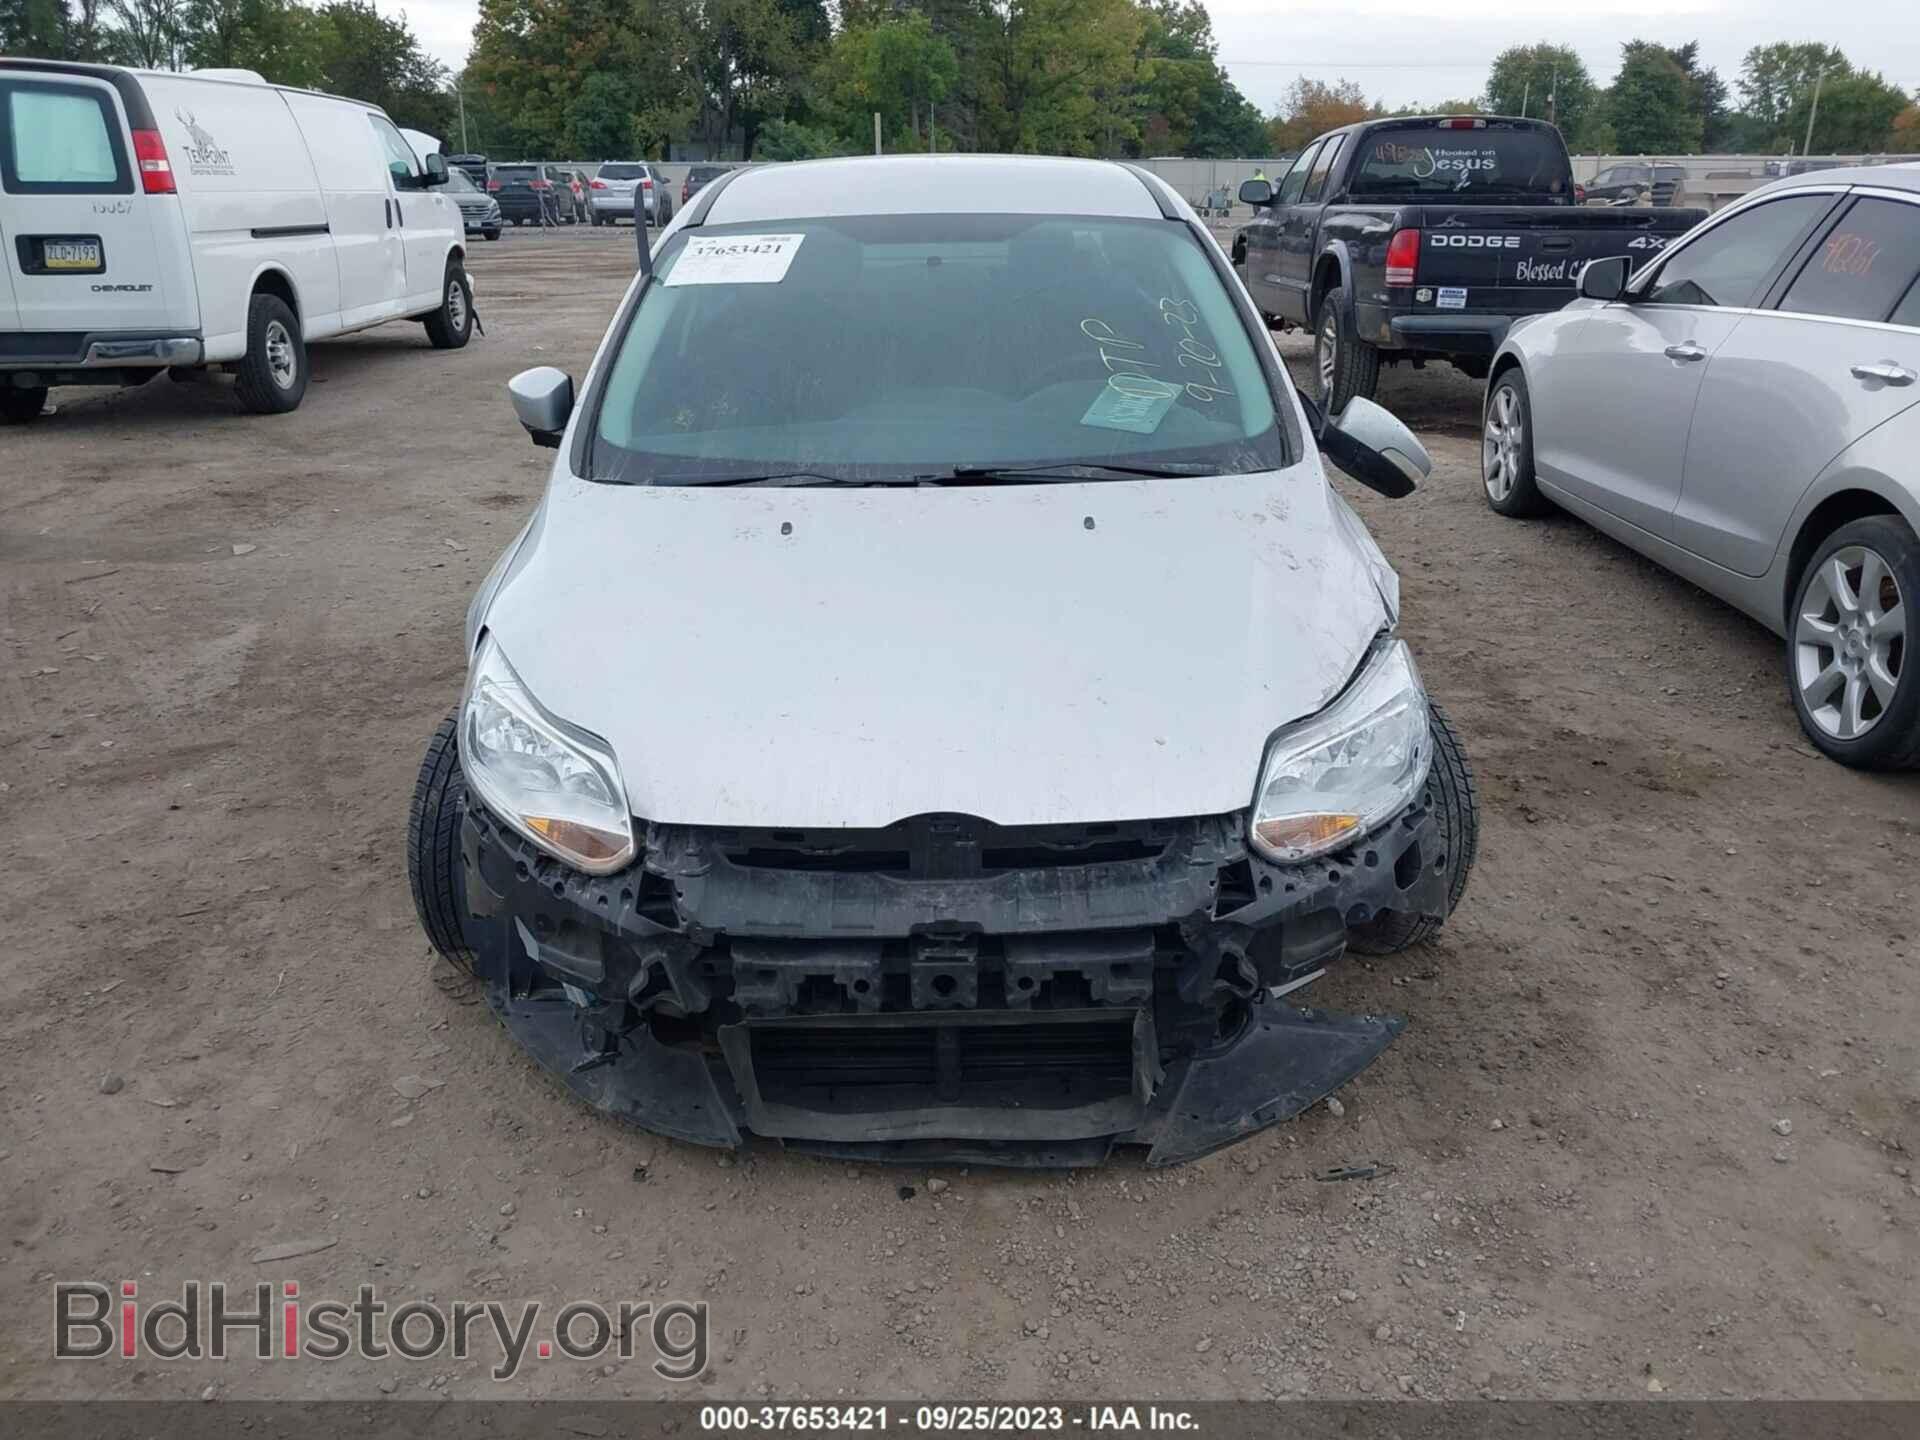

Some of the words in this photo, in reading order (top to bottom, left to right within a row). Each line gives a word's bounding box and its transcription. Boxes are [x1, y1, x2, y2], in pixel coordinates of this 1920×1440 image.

[1435, 148, 1478, 156] Hooked
[1413, 146, 1496, 178] Jesus
[1430, 235, 1521, 248] DODGE
[690, 243, 784, 258] 37653421
[1516, 256, 1566, 281] Blessed
[91, 284, 153, 292] CHEVROLET
